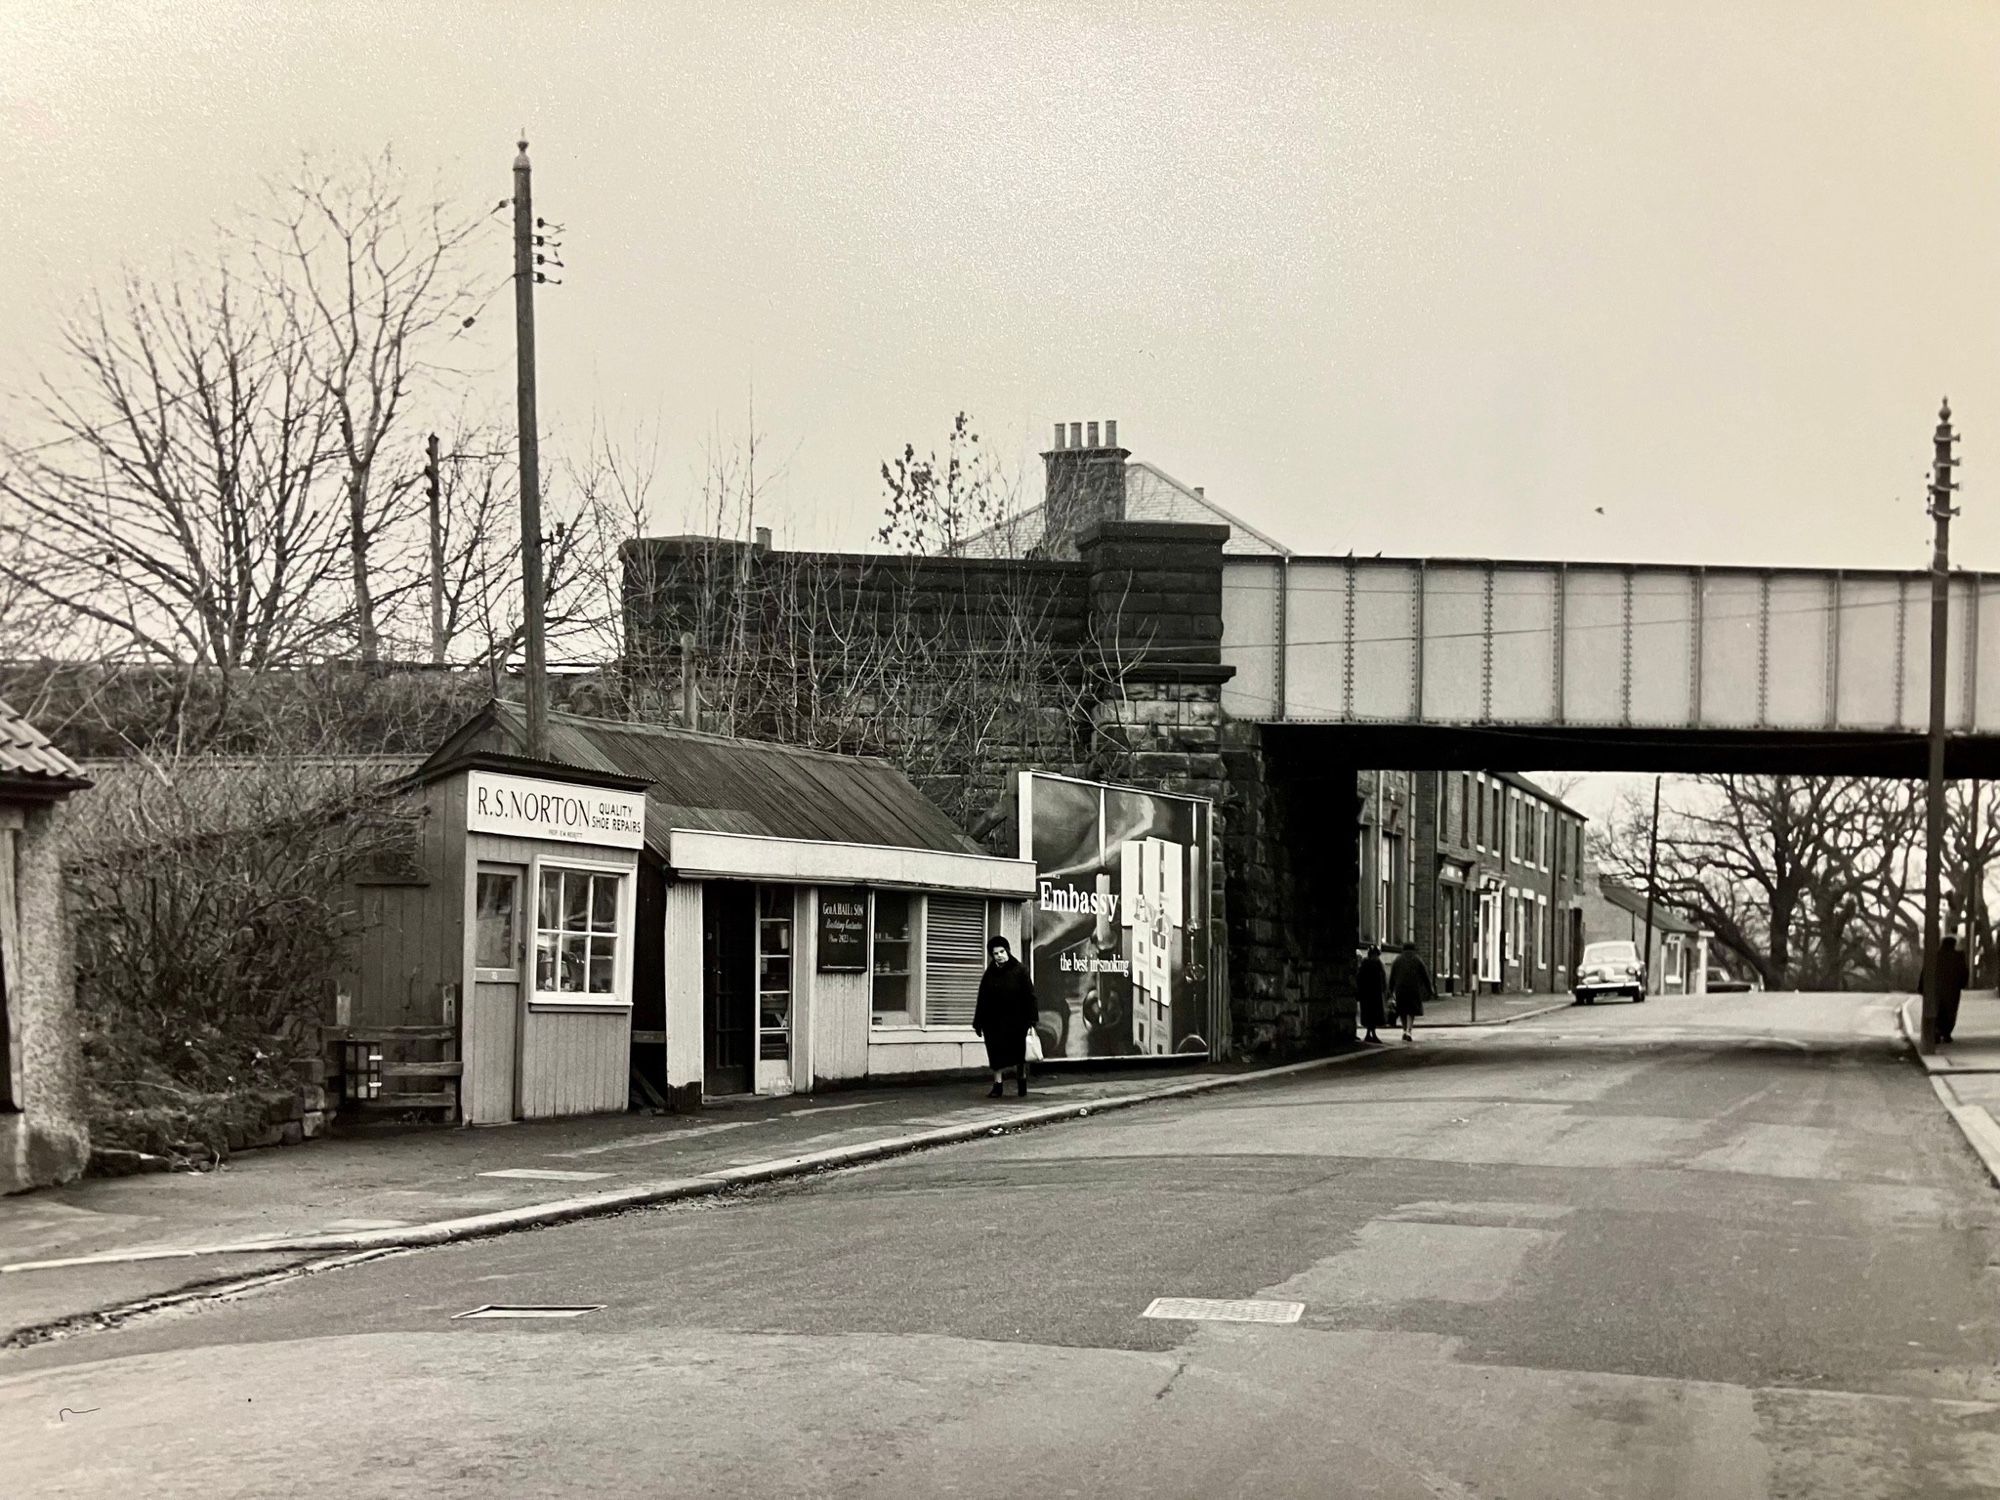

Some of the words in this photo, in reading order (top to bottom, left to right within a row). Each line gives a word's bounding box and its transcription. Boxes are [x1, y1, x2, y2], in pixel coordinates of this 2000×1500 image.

[599, 802, 632, 817] QUALITY
[592, 816, 609, 830] SHOE
[612, 818, 641, 833] REPAIRS
[1040, 881, 1119, 922] Embassy
[1060, 952, 1072, 972] the
[1073, 952, 1088, 972] best
[1090, 953, 1099, 973] in
[1099, 954, 1130, 978] smoking
